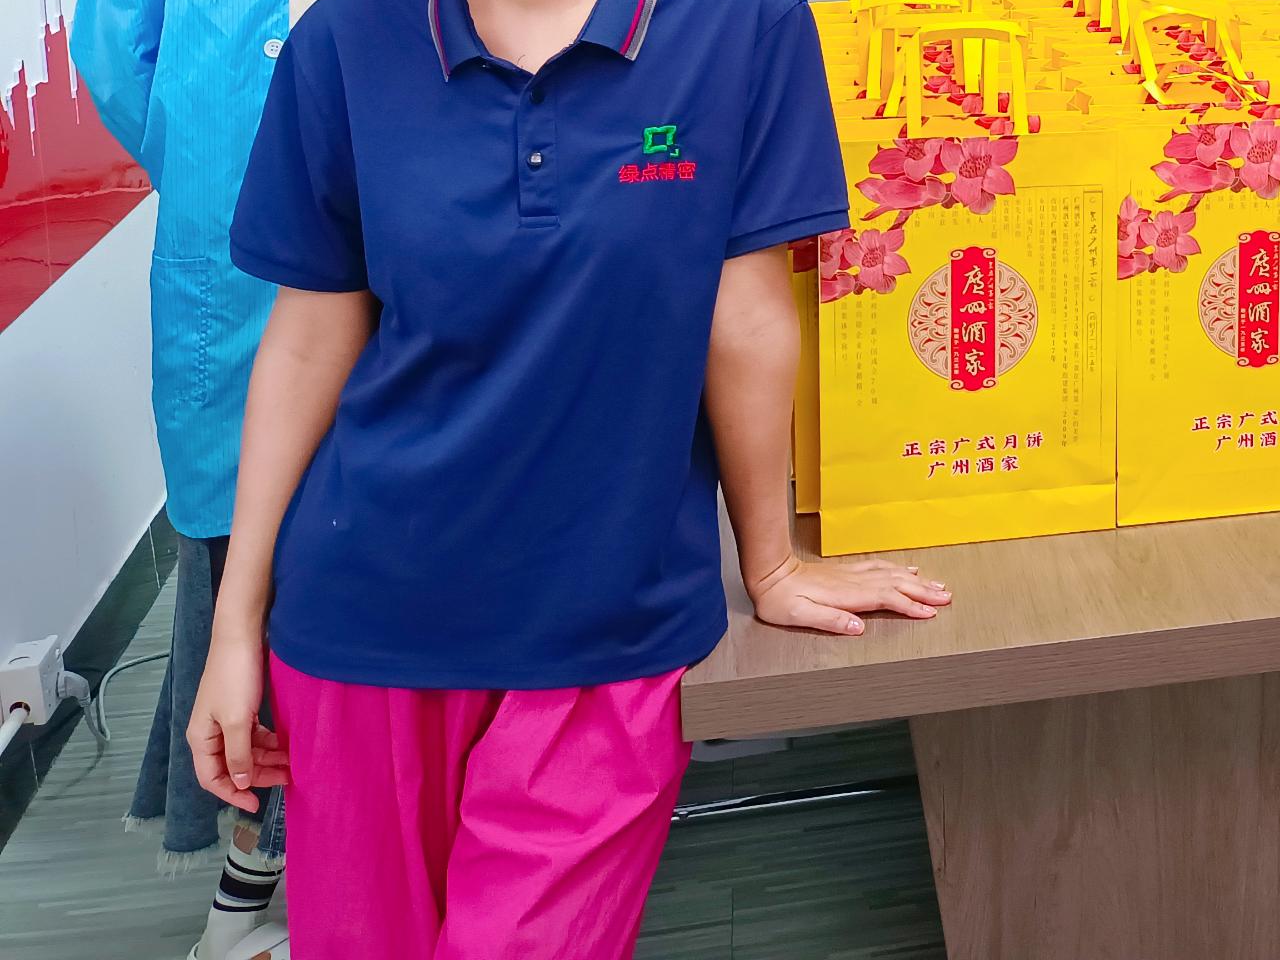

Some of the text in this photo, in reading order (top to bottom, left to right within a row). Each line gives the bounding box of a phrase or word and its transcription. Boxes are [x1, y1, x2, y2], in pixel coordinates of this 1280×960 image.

[619, 161, 696, 183] 绿点精密
[902, 431, 1044, 458] 正宗广式月饼
[927, 455, 1019, 479] 广州酒家
